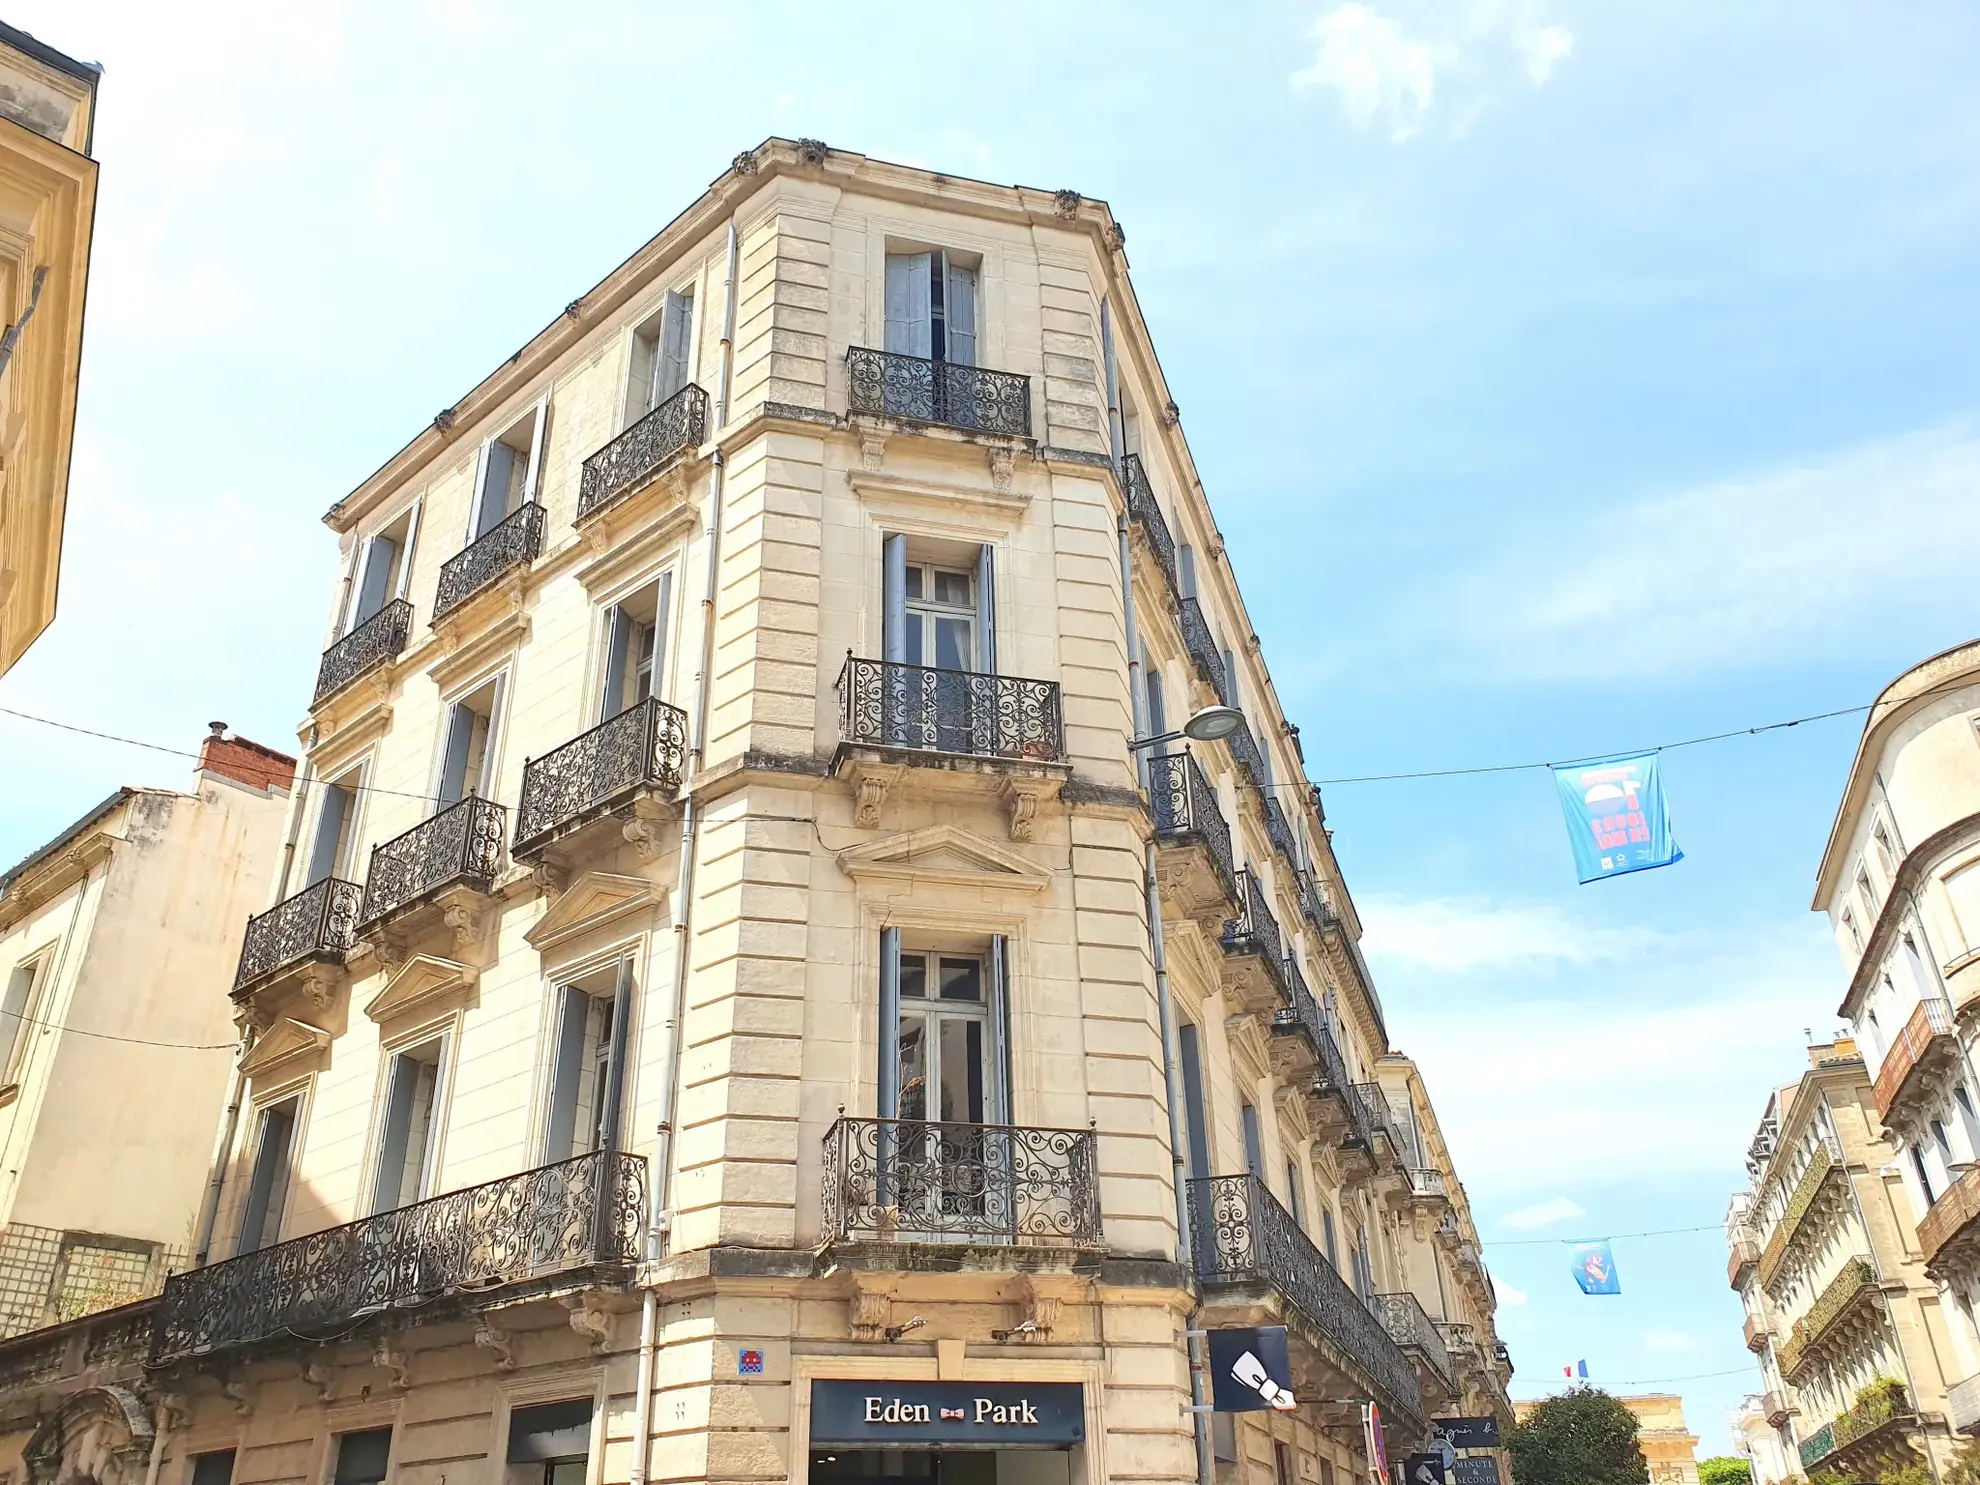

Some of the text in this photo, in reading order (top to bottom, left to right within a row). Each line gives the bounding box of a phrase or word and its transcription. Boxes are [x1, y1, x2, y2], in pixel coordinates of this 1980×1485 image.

[864, 1396, 1039, 1424] Eden Park
[1456, 1460, 1494, 1468] MINUTE
[1457, 1476, 1498, 1484] SECONDE
